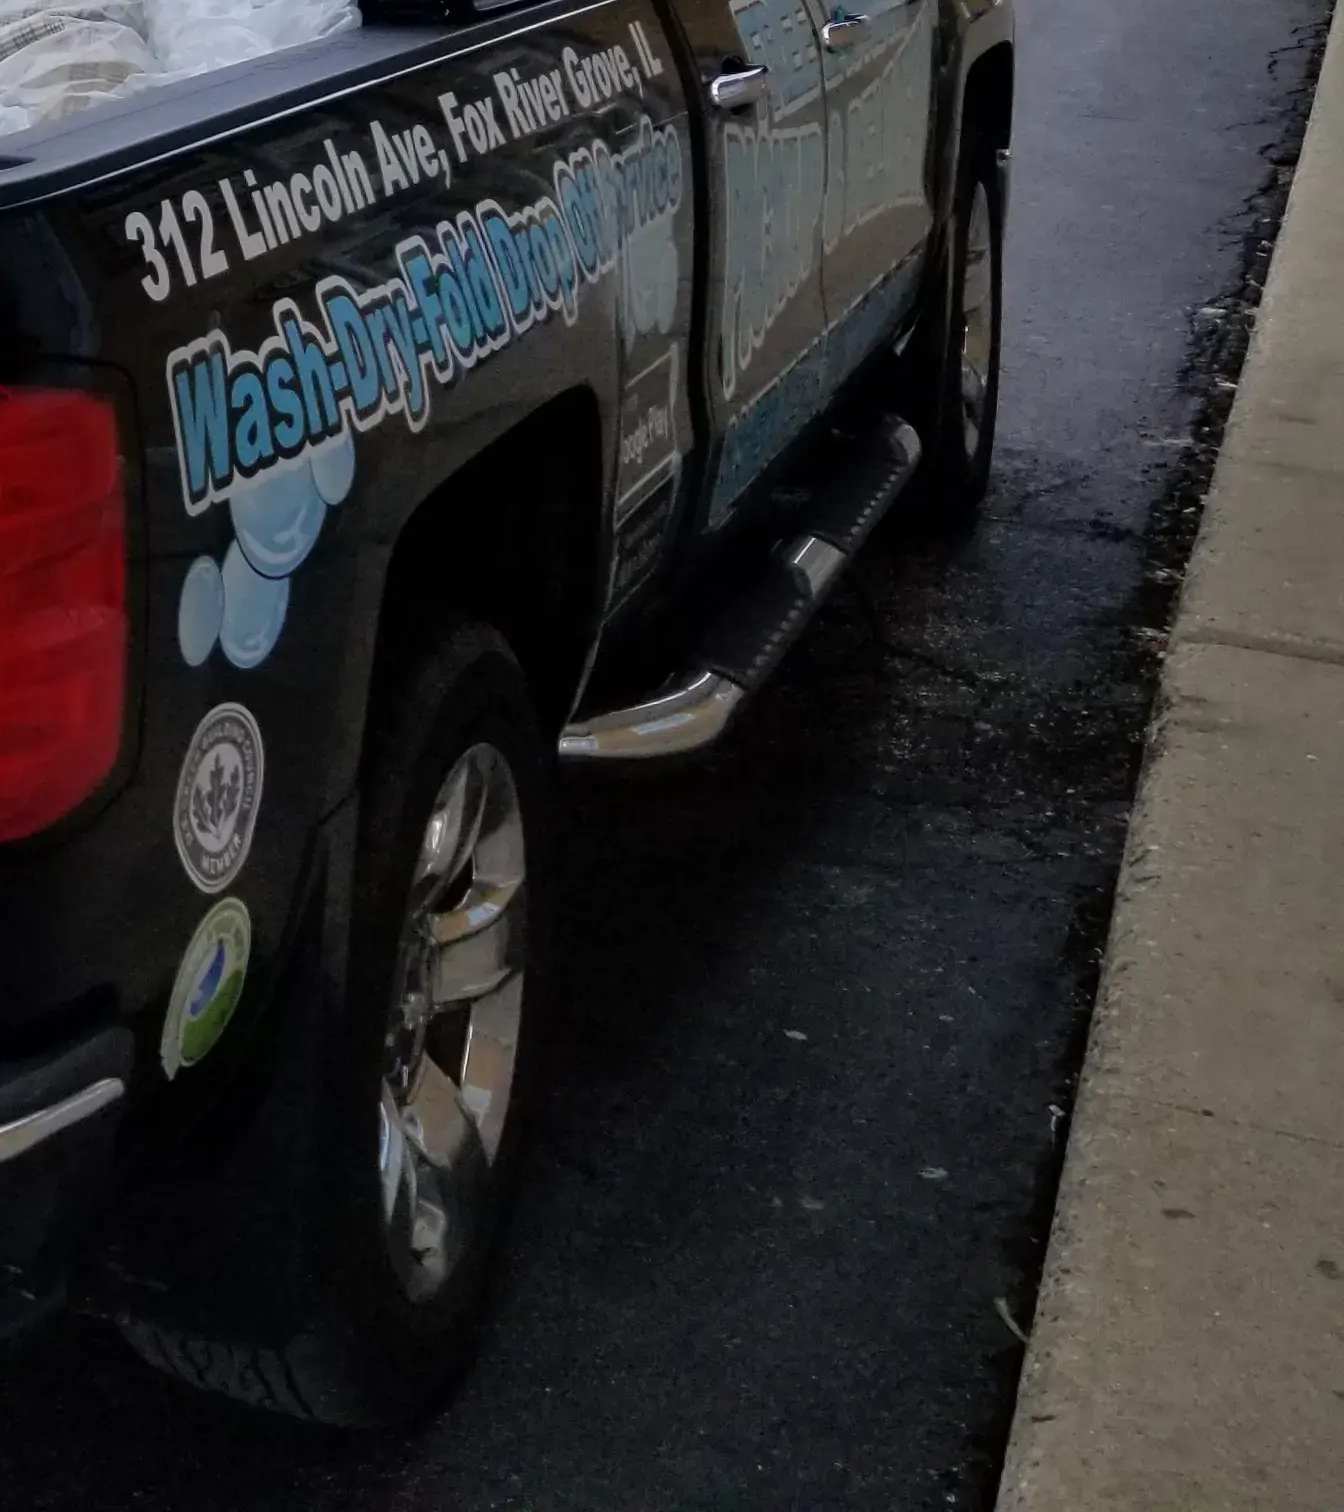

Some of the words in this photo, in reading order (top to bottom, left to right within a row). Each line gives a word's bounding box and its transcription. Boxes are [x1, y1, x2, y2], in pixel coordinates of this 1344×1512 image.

[125, 189, 228, 302] 312
[218, 140, 379, 261] Lincoln
[369, 120, 451, 189] Ave,
[438, 91, 507, 163] Fox
[493, 71, 569, 140] River
[560, 47, 644, 100] Grove,
[628, 21, 663, 85] IL
[170, 212, 512, 506] Wash-Dry-Fold
[479, 201, 577, 323] Drop
[557, 148, 606, 282] Off
